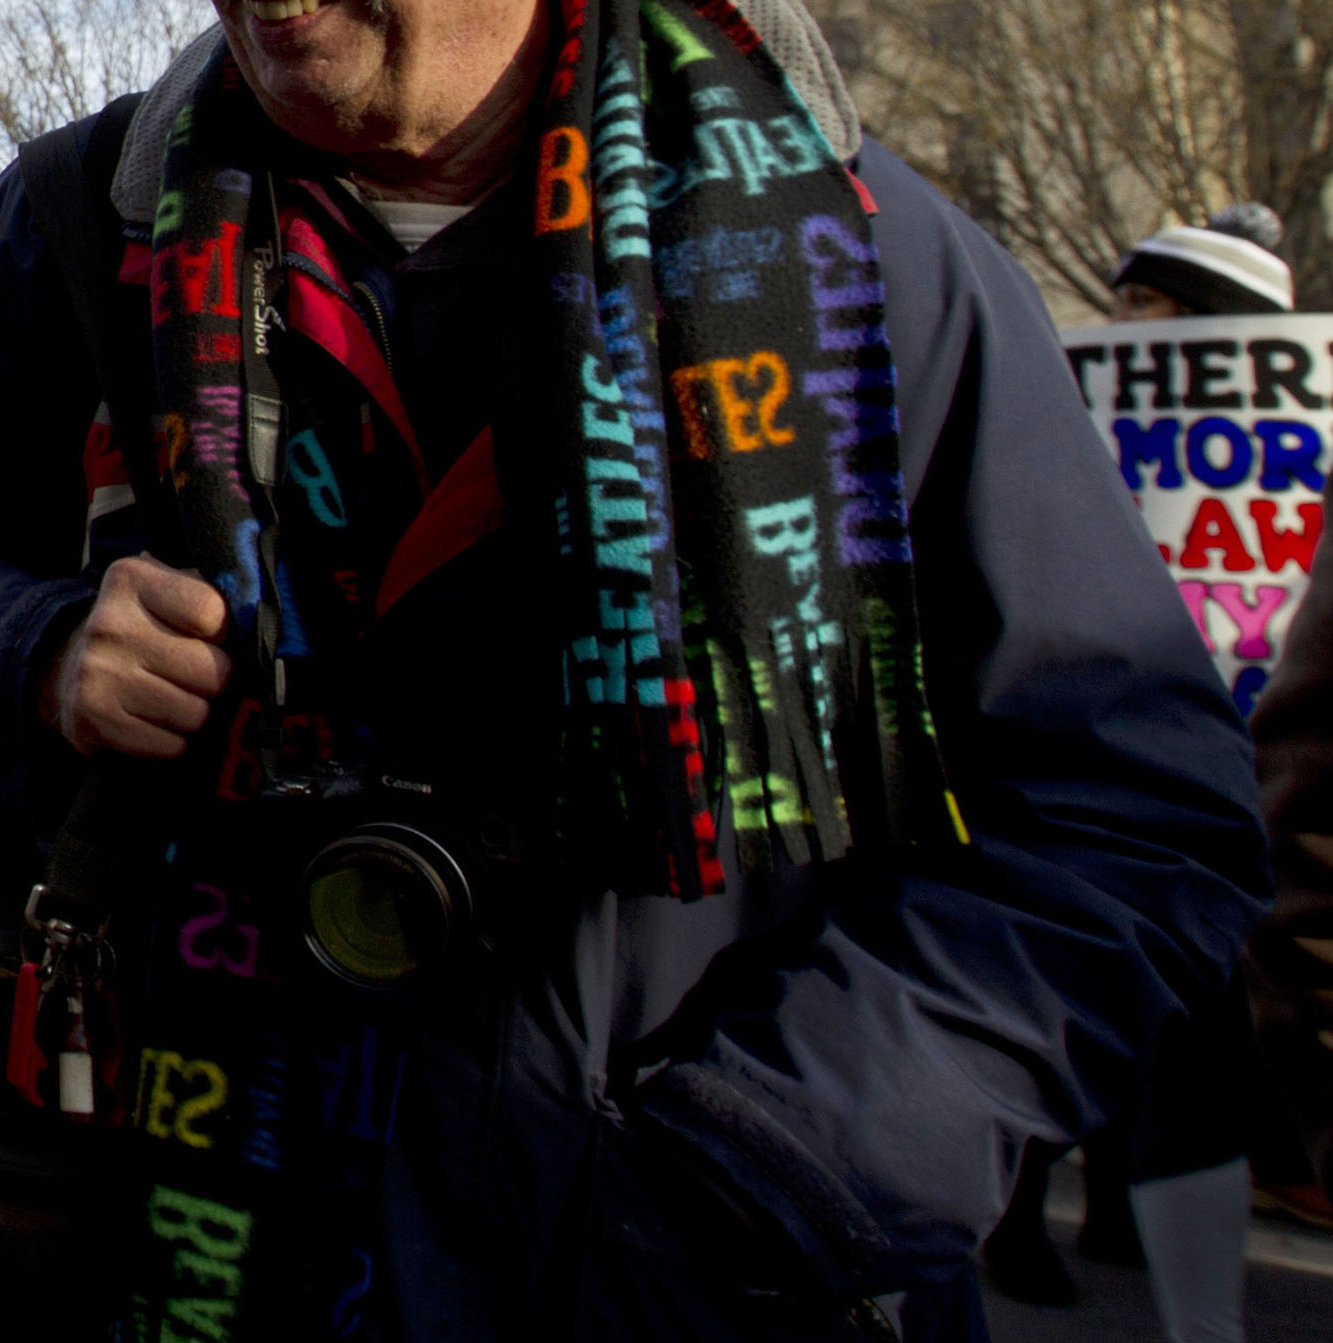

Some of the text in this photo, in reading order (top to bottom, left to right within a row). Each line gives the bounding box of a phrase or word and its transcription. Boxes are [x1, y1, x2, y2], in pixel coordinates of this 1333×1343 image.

[254, 241, 286, 357] PowerShot
[1066, 338, 1333, 410] THER
[1112, 415, 1333, 492] MOR
[1131, 496, 1323, 573] AW
[381, 773, 433, 795] Canon
